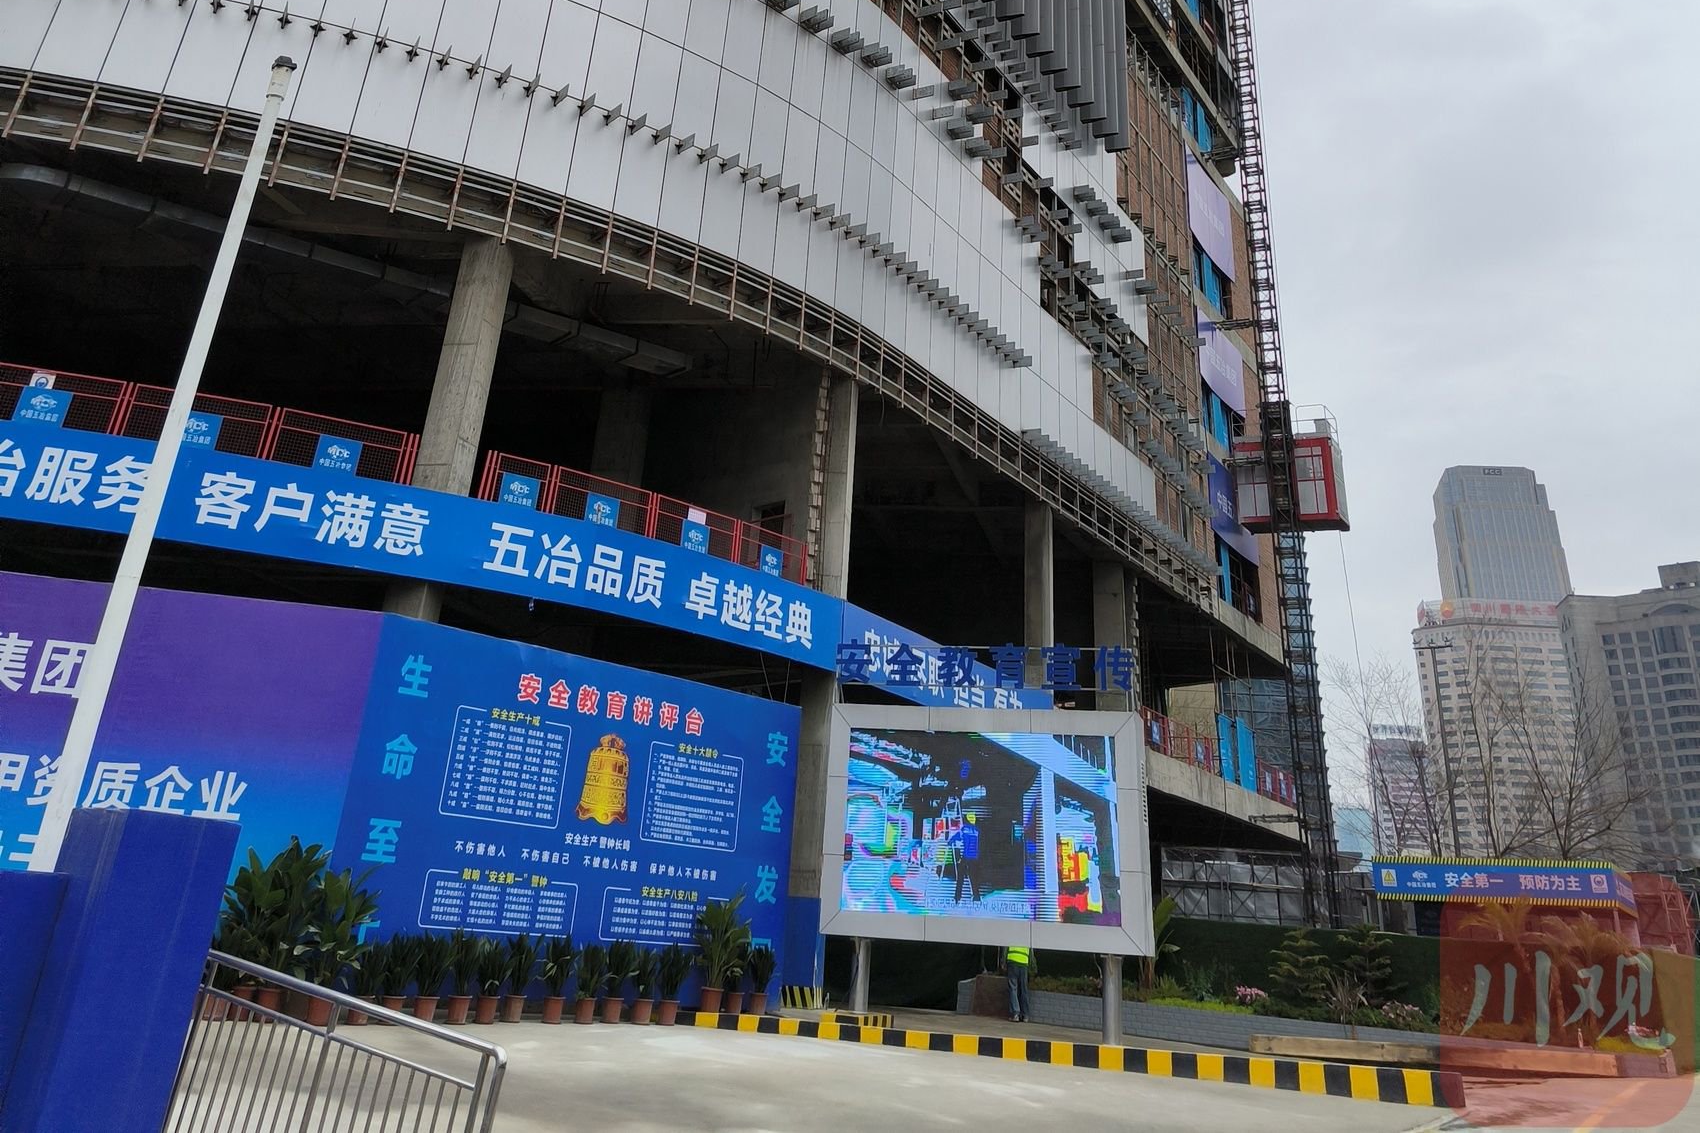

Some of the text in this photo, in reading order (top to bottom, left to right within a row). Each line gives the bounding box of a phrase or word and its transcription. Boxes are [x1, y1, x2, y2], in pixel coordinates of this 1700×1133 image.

[195, 471, 430, 556] 客户满意
[482, 522, 666, 609] 五冶品质
[684, 571, 813, 650] 卓越经典
[836, 638, 1135, 692] 安全教育宣传
[491, 707, 541, 726] 安全生产十戒
[517, 672, 706, 736] 安全教育讲评台
[454, 840, 718, 882] 不伤害他人 不伤害自己 不被他人伤害 保护他人不被伤害
[1444, 872, 1582, 892] 安全第一 预防为主
